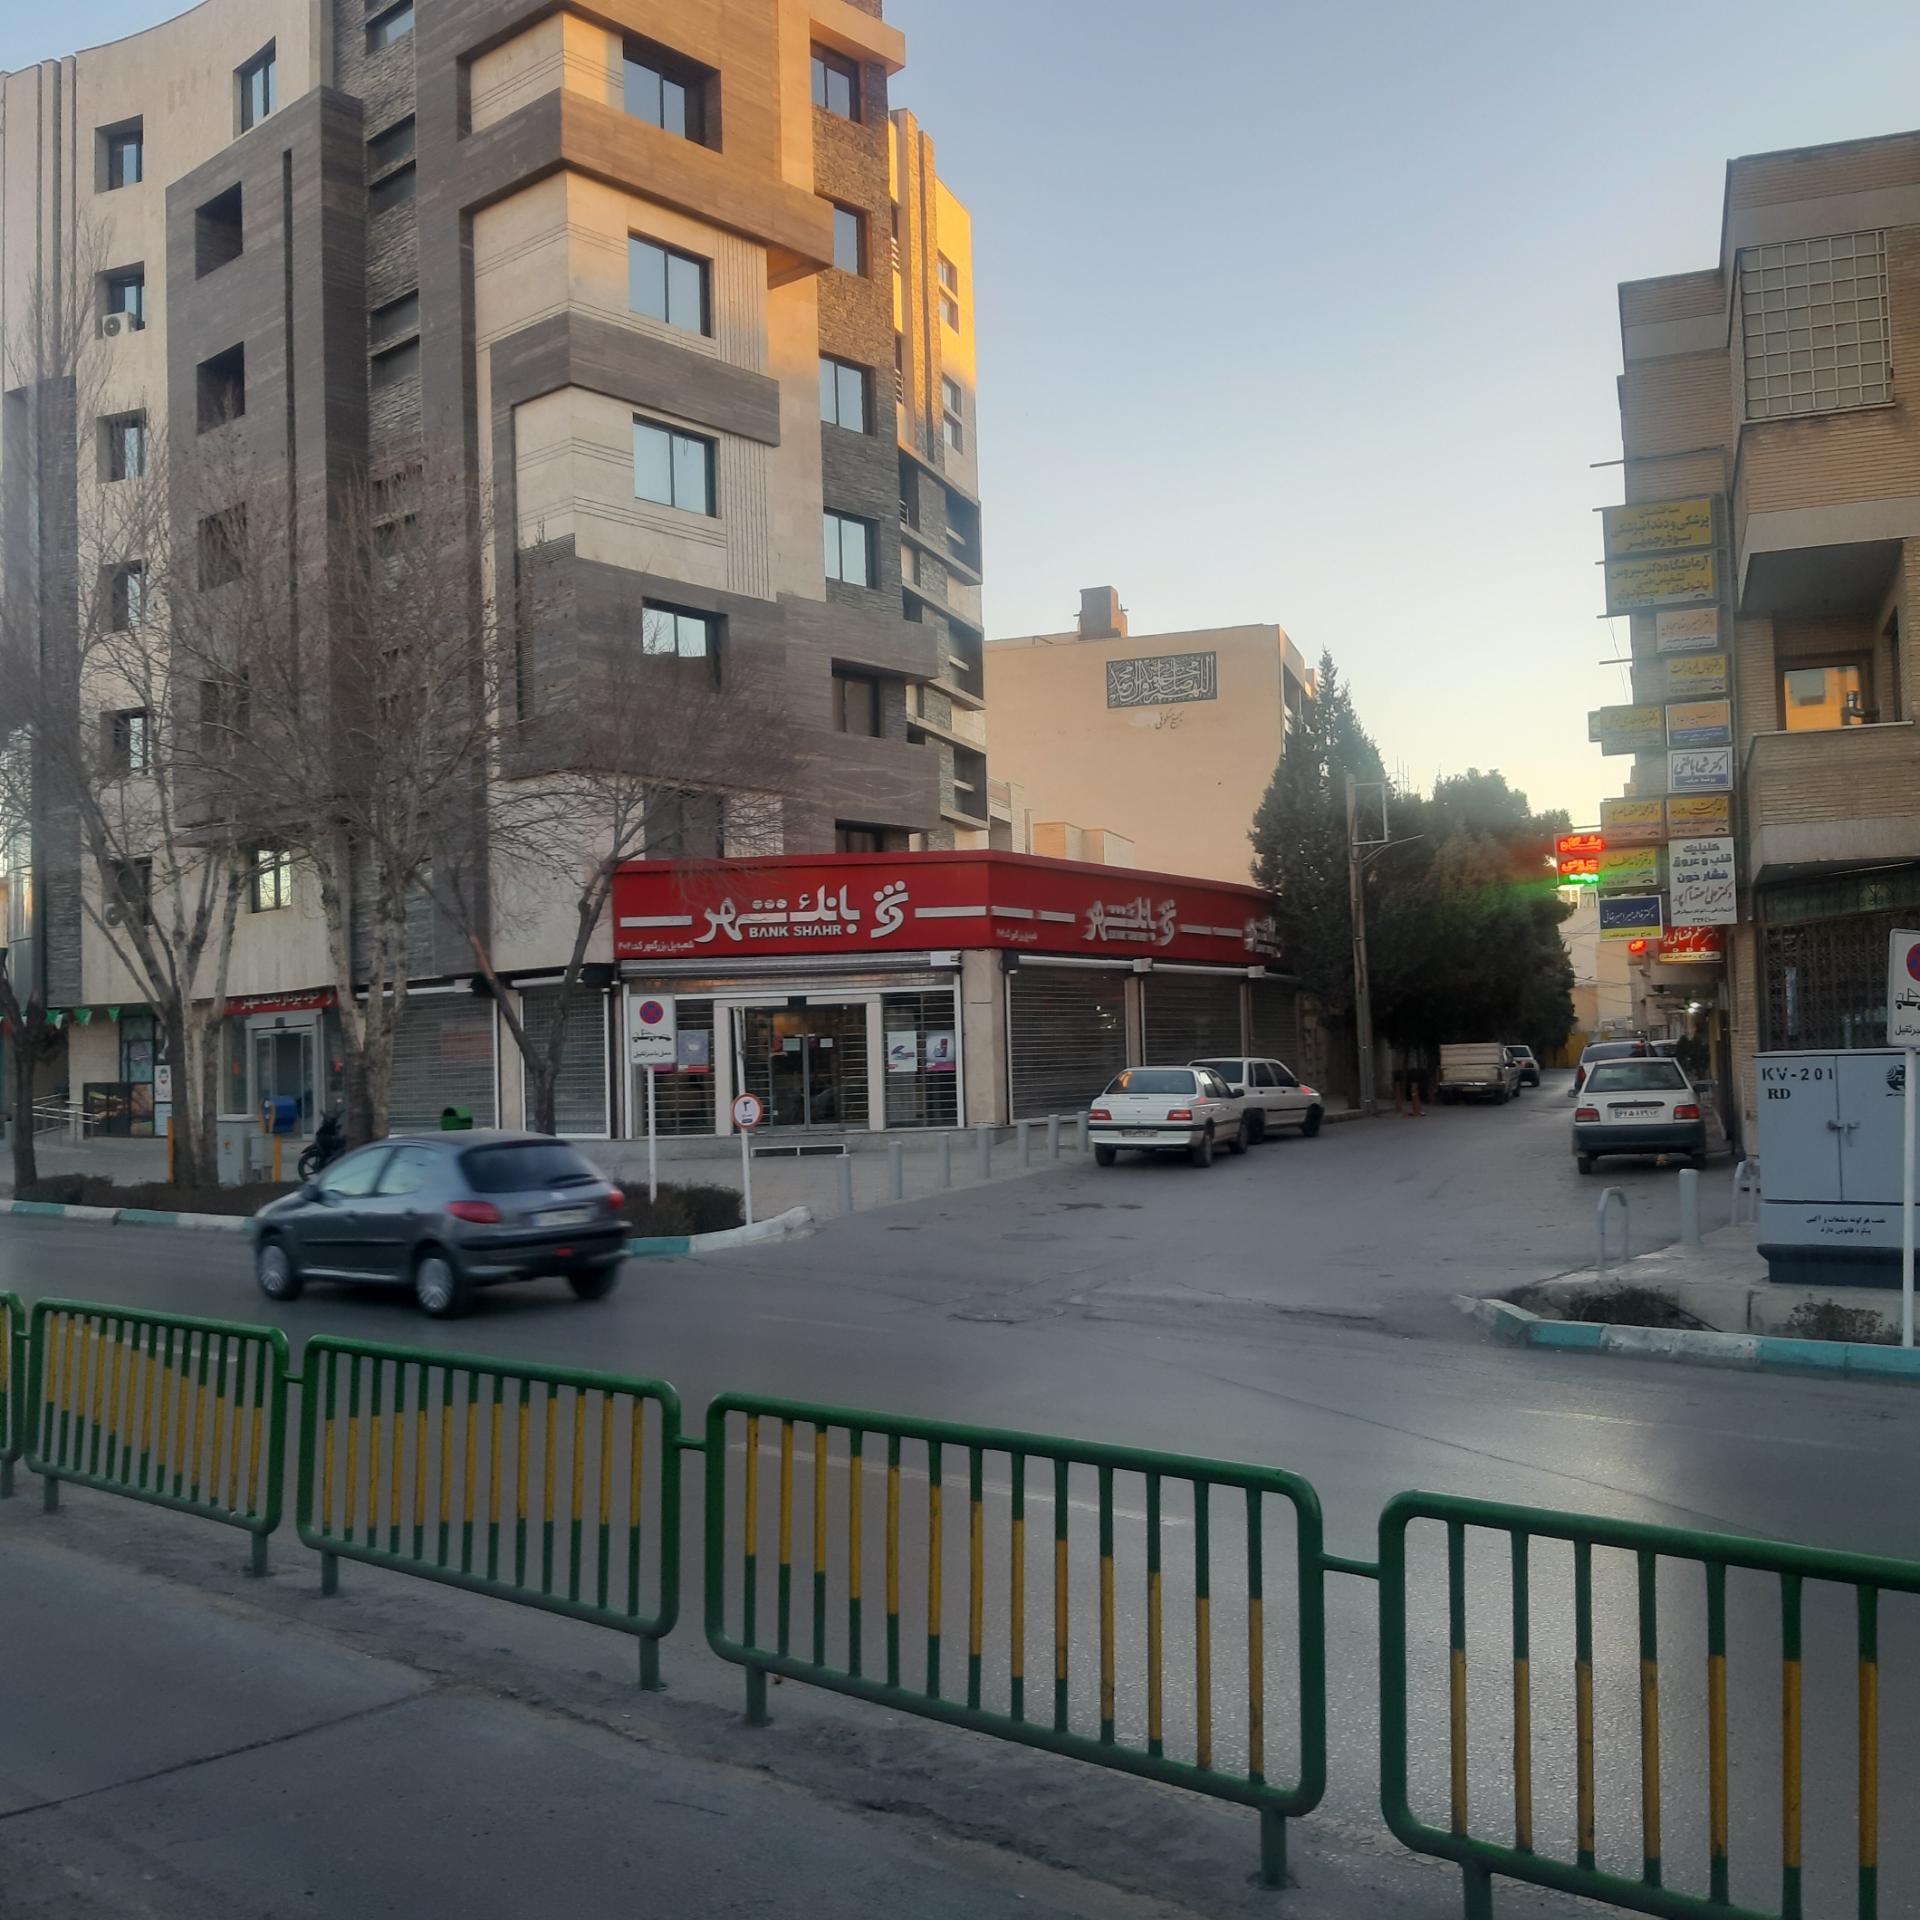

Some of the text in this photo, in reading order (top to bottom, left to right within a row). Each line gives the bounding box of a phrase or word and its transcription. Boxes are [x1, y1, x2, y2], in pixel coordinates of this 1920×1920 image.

[694, 884, 861, 943] بانک شهر
[748, 923, 843, 938] BANK SHAHR
[1761, 1066, 1834, 1082] KV-201
[1767, 1087, 1791, 1100] RD
